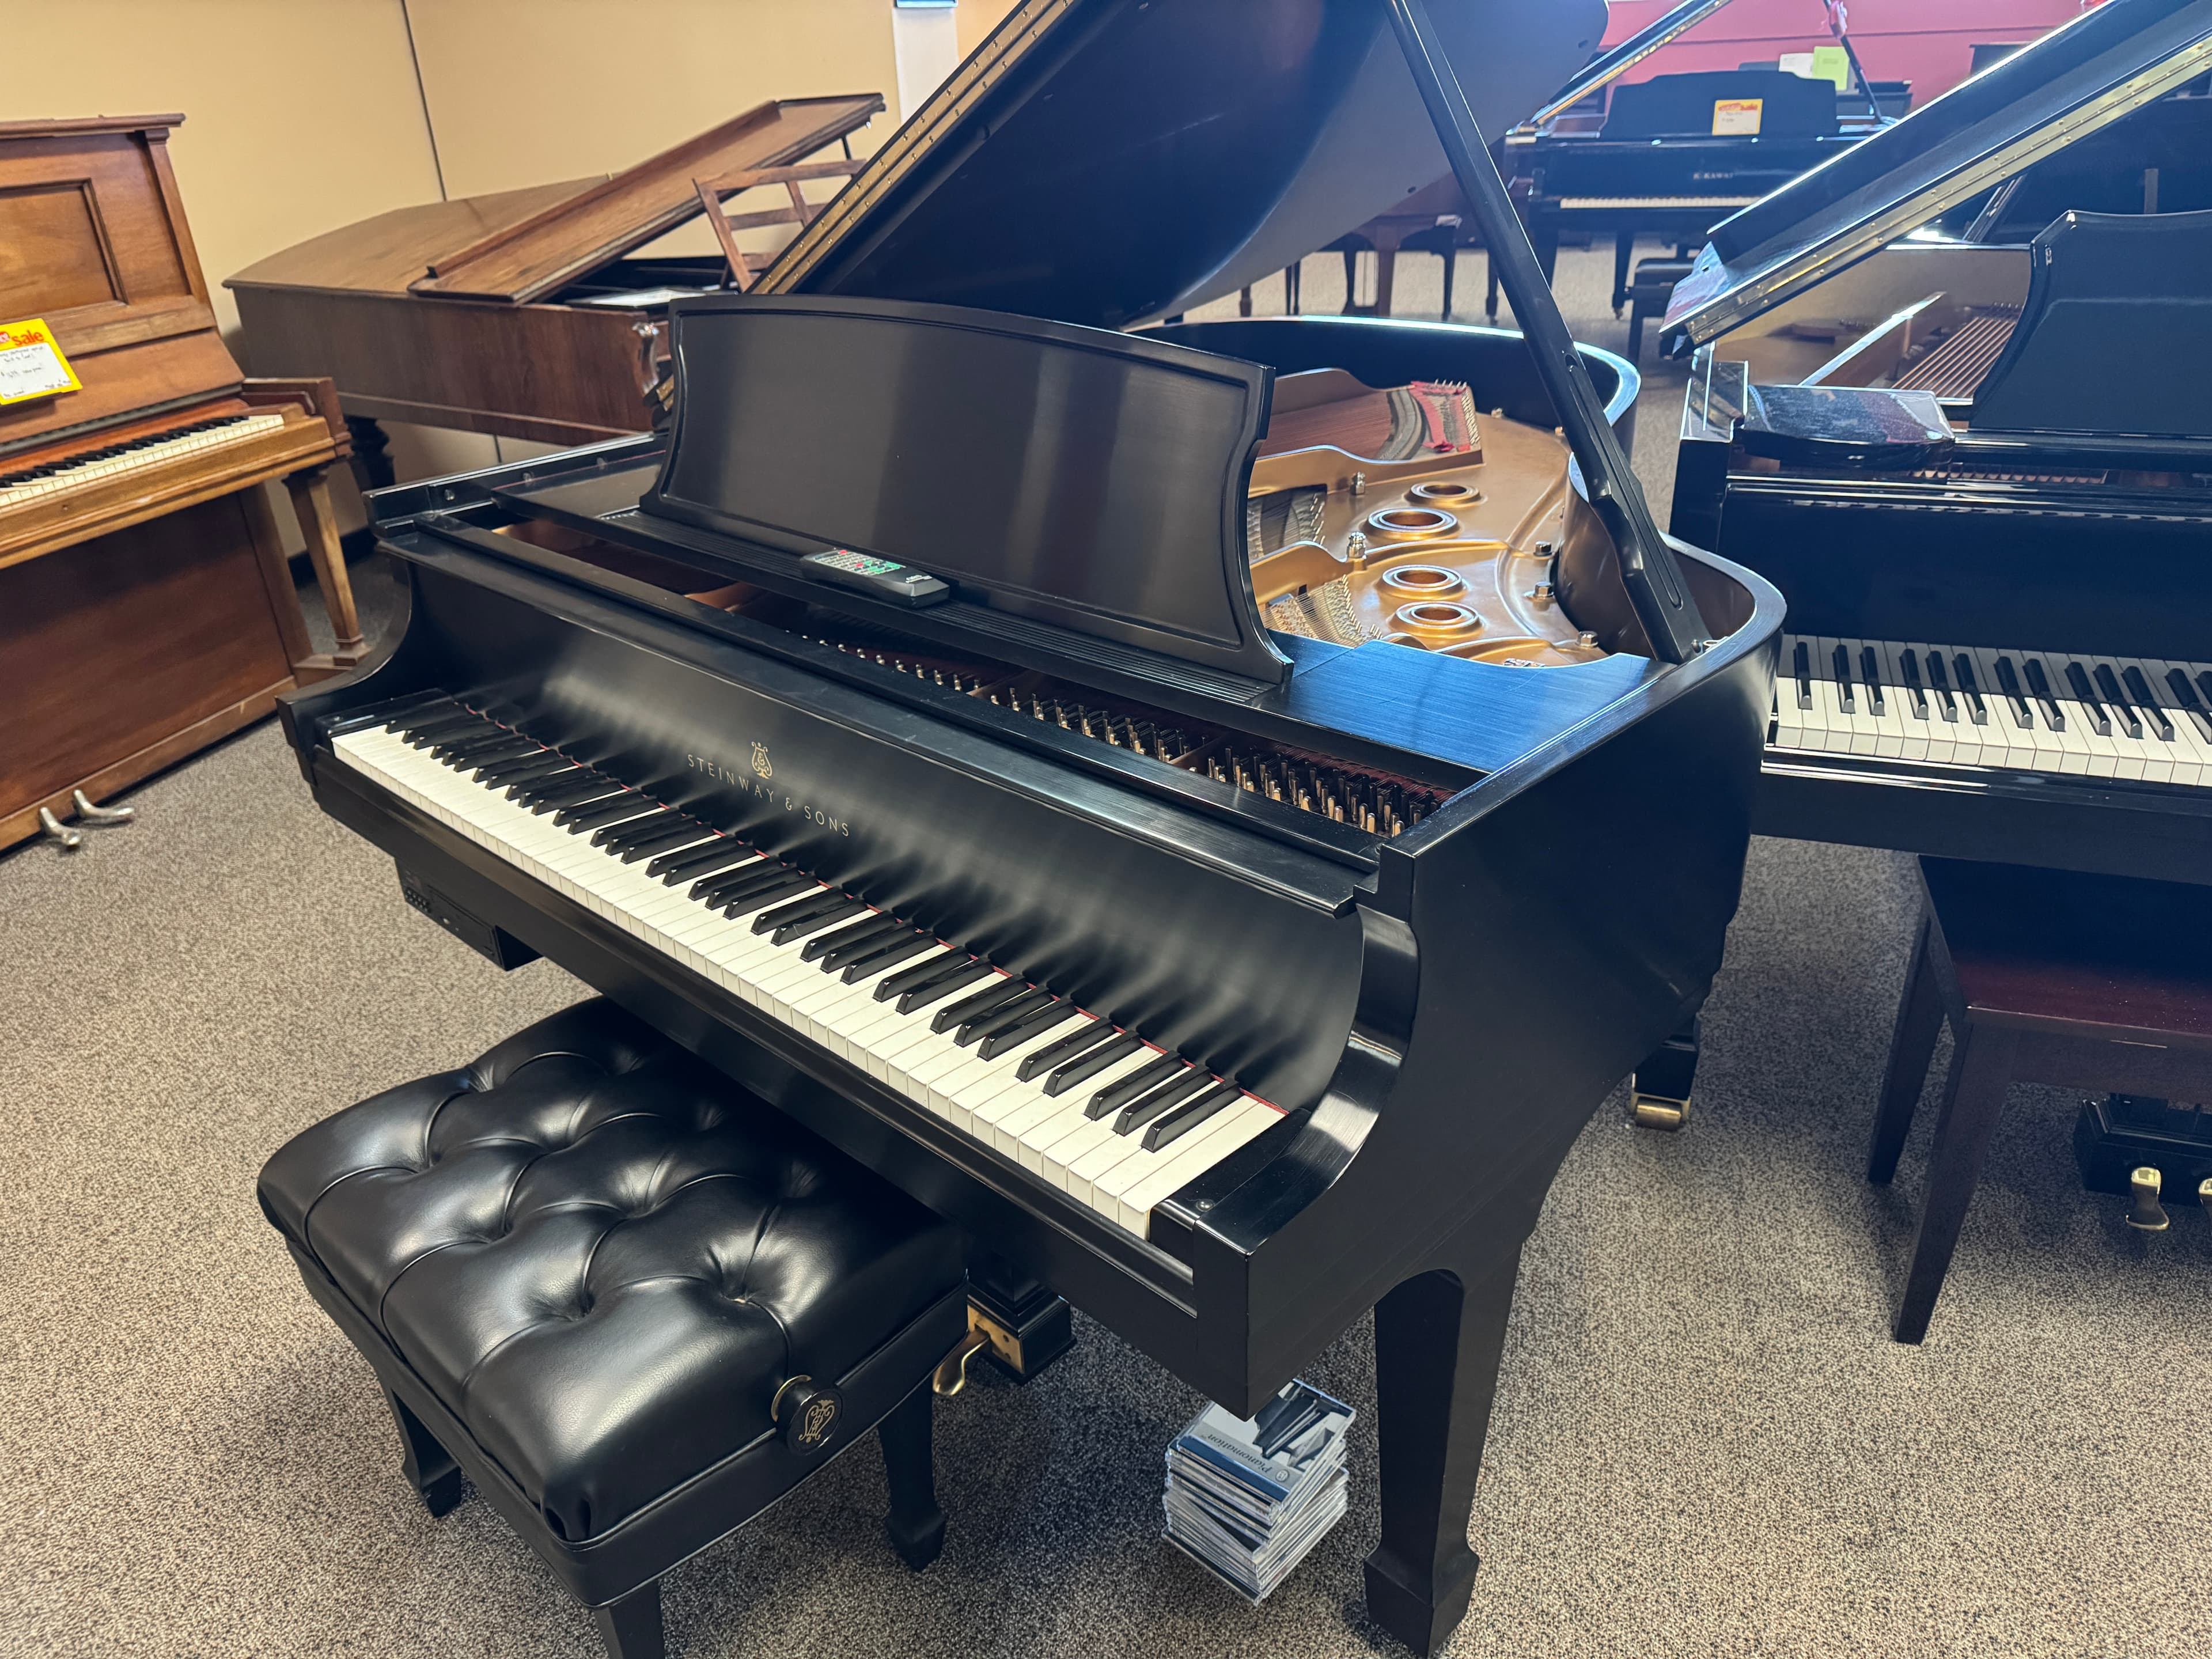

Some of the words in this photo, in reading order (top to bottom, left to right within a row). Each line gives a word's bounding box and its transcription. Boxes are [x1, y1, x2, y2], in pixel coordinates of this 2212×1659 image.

[12, 329, 44, 346] sale
[687, 753, 774, 803] STEINWAY
[785, 797, 793, 811] &
[804, 805, 850, 837] SONS
[1207, 1433, 1272, 1473] Pianomation
